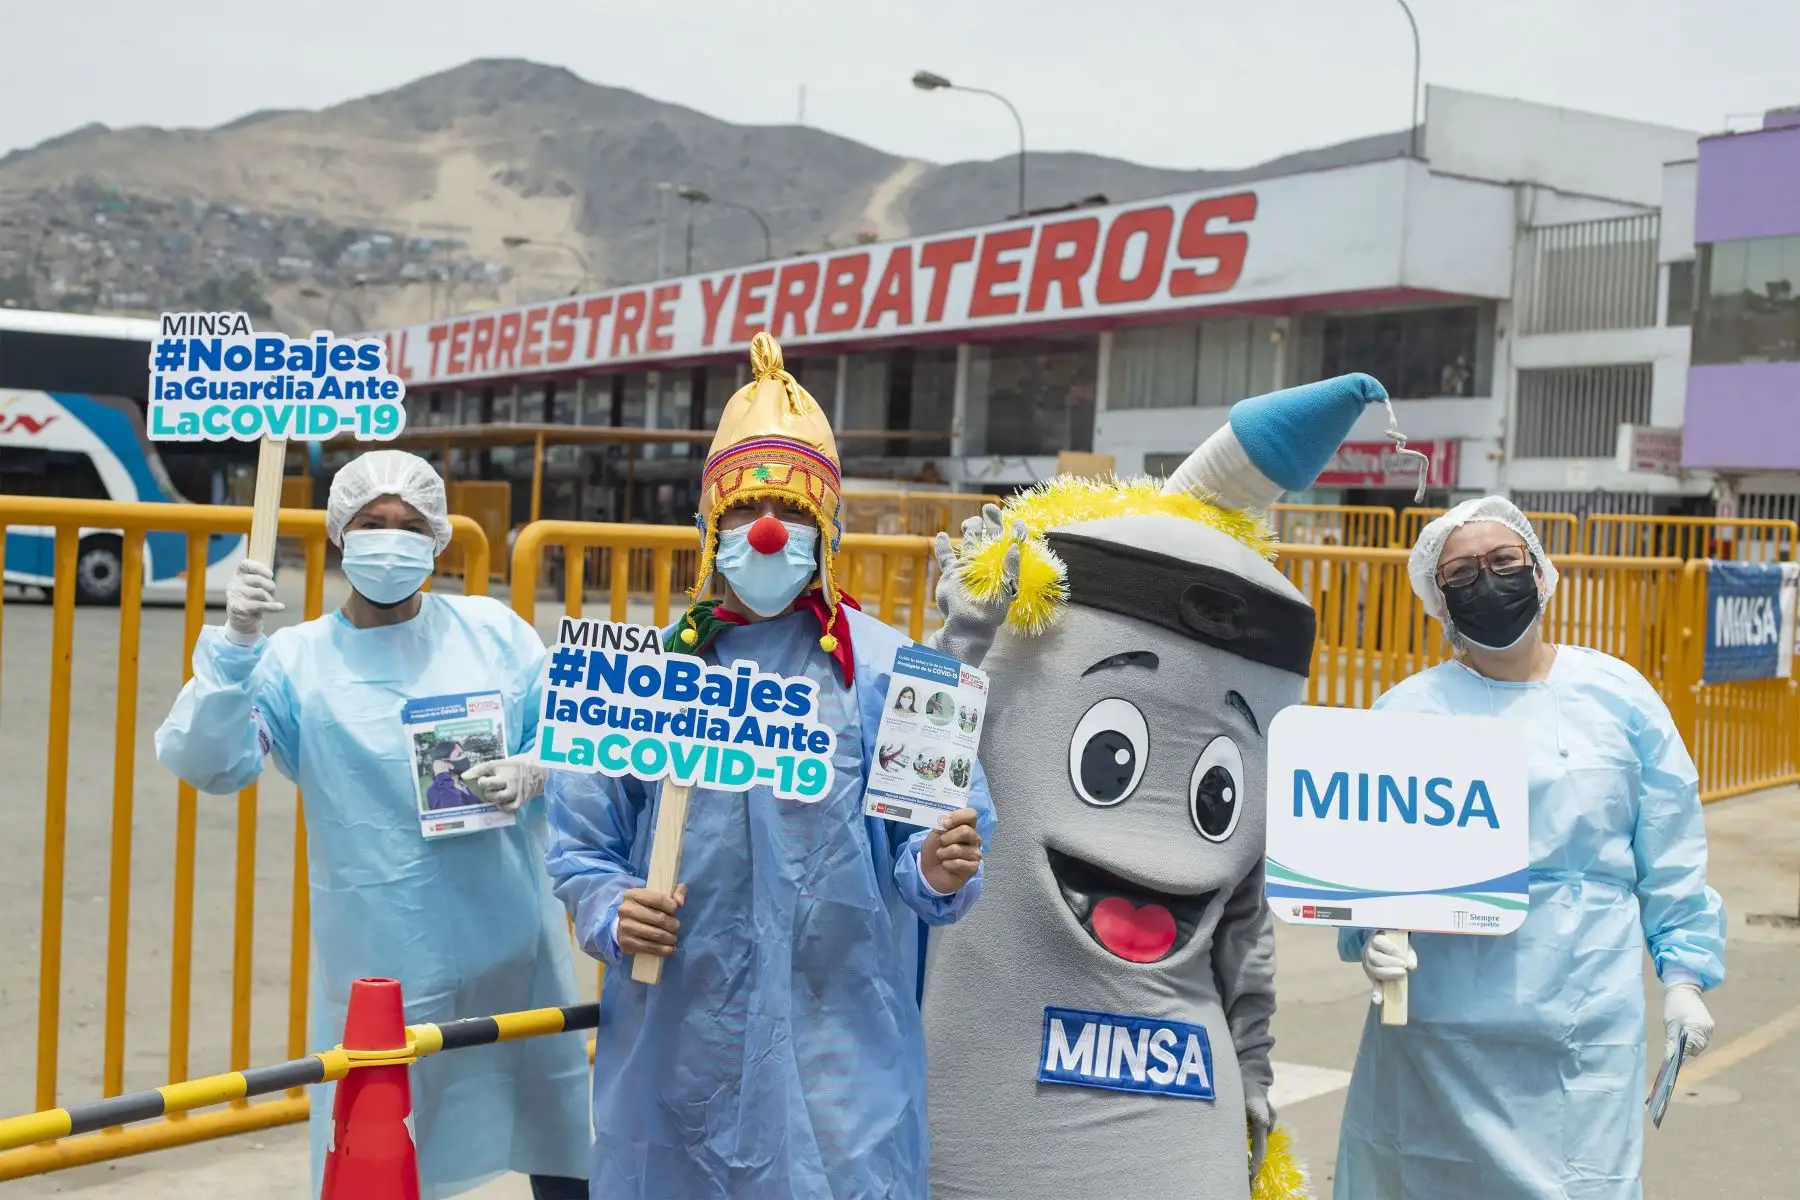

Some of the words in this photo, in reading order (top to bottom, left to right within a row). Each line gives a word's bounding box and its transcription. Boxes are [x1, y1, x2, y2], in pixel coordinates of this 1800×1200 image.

[428, 285, 681, 377] TERRESTRE
[701, 192, 1258, 346] YERBATEROS
[162, 315, 249, 336] MINSA
[155, 336, 381, 379] #NoBajes
[152, 404, 399, 435] LaCOVID-19
[560, 619, 661, 655] MINSA
[1715, 596, 1778, 647] MINSA
[548, 647, 812, 718] #NoBajes
[932, 668, 958, 679] COVID-19
[540, 726, 828, 797] LaCOVID-19
[1293, 769, 1500, 830] MINSA
[1045, 1018, 1211, 1088] MINSA
